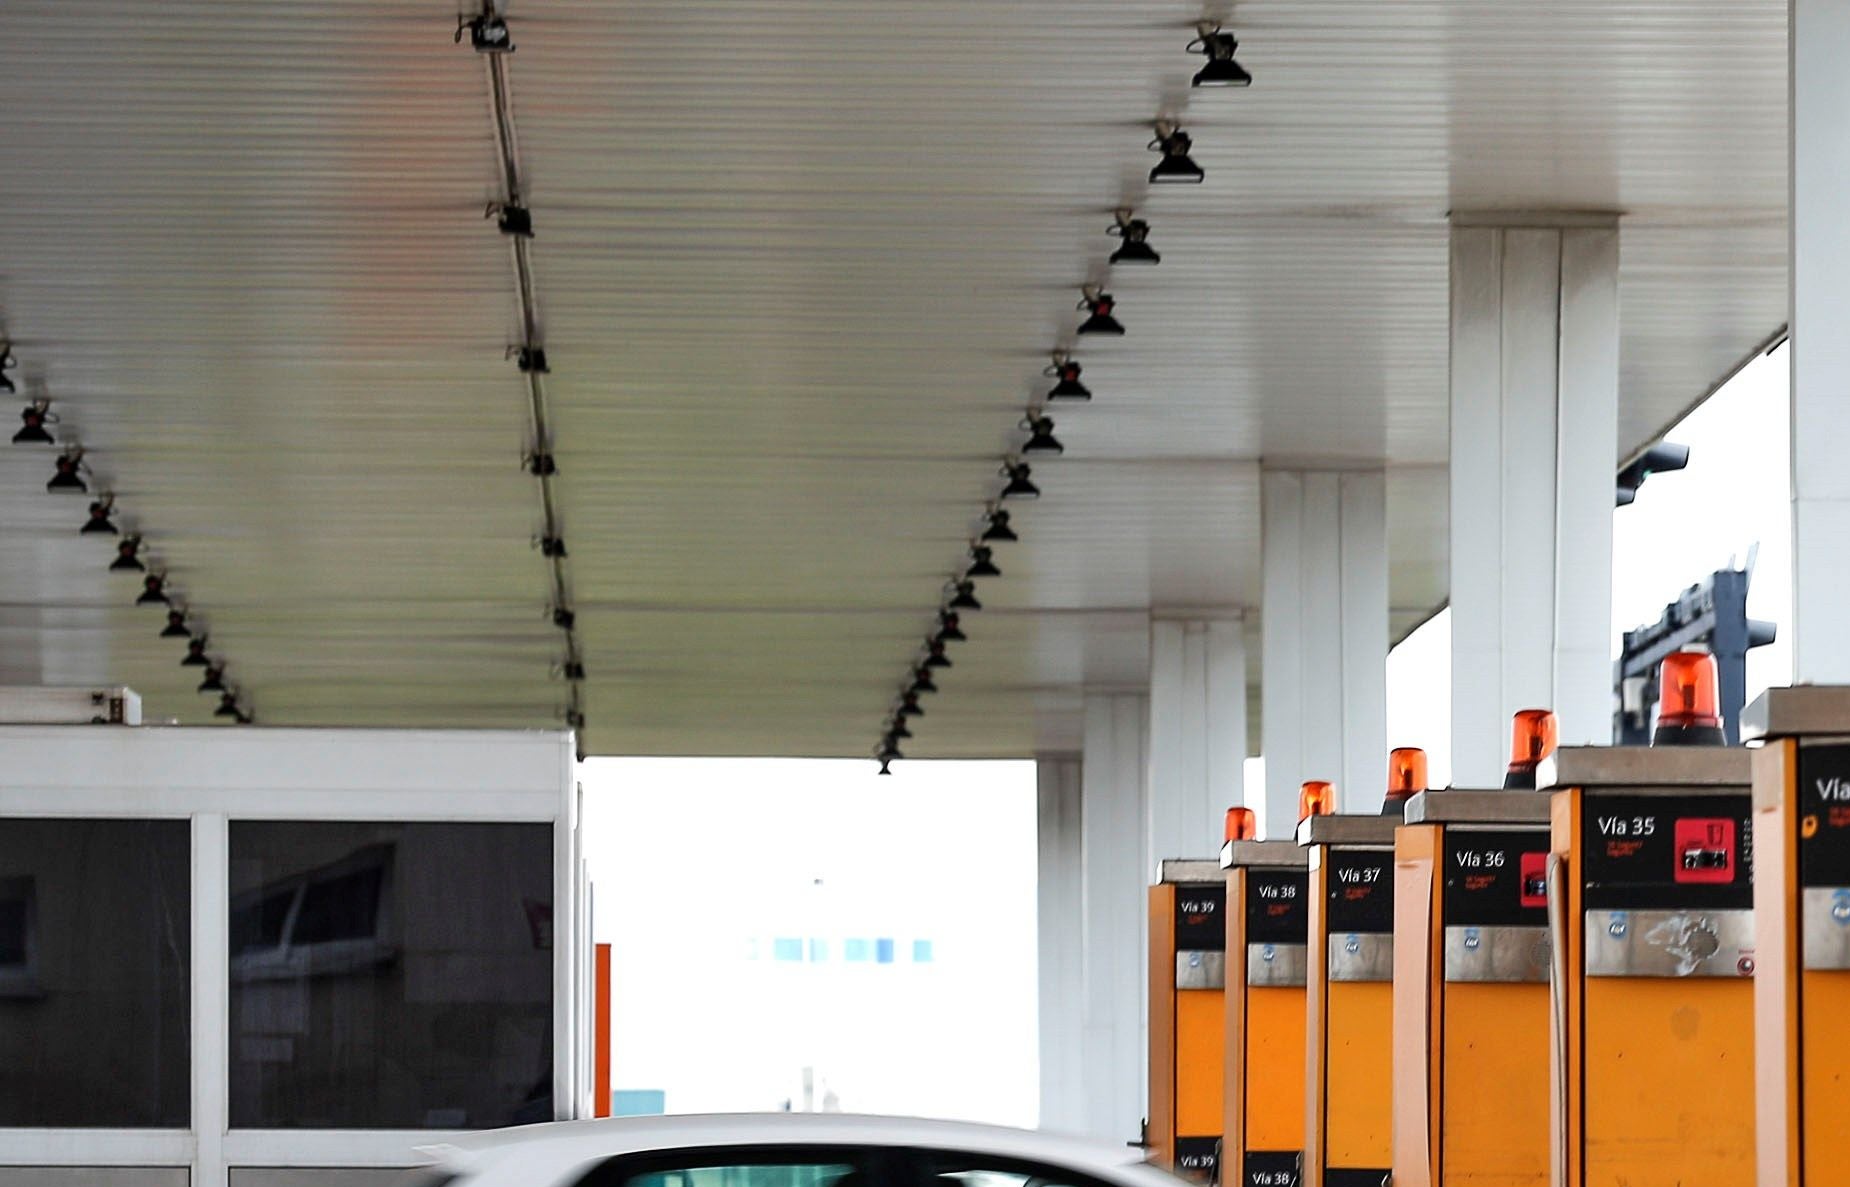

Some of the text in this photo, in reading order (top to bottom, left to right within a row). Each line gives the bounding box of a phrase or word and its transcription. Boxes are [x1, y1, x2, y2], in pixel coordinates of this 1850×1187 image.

[1632, 816, 1656, 836] 35
[1485, 850, 1505, 868] 36
[1363, 867, 1381, 883] 37
[1280, 885, 1296, 899] 38
[1201, 901, 1215, 914] 39
[1200, 1155, 1215, 1168] 39
[1274, 1173, 1290, 1186] 38
